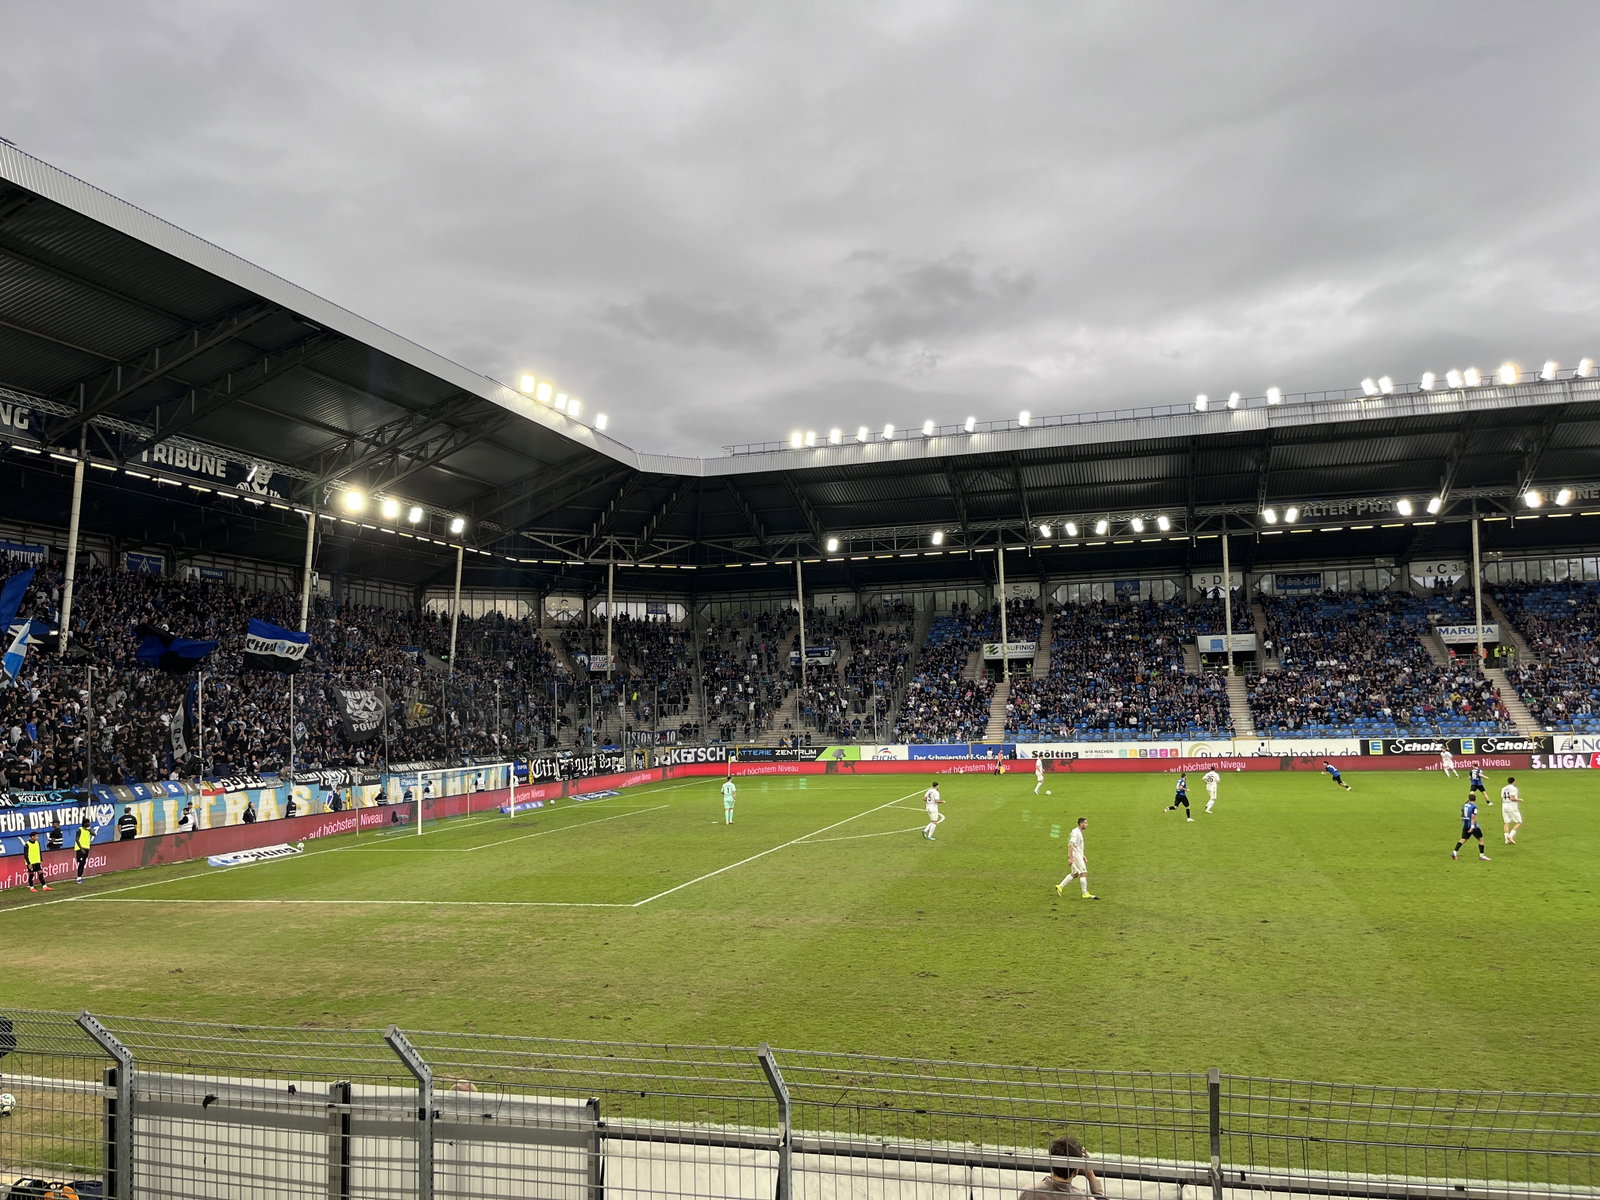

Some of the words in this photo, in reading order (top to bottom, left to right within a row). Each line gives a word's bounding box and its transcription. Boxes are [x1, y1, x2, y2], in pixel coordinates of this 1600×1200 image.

[1437, 563, 1447, 574] C
[1213, 575, 1222, 585] D
[831, 595, 838, 604] F
[1390, 738, 1443, 753] Scholz
[1482, 738, 1538, 753] Scholz
[671, 748, 726, 763] KETSCH
[1031, 749, 1079, 759] Stölting
[1183, 762, 1219, 772] höchstem
[1220, 760, 1246, 769] Niveau
[1482, 757, 1511, 767] Niveau
[777, 764, 799, 772] Niveau
[0, 810, 26, 833] FÜR
[29, 809, 54, 830] DEN
[360, 813, 384, 826] Niveau
